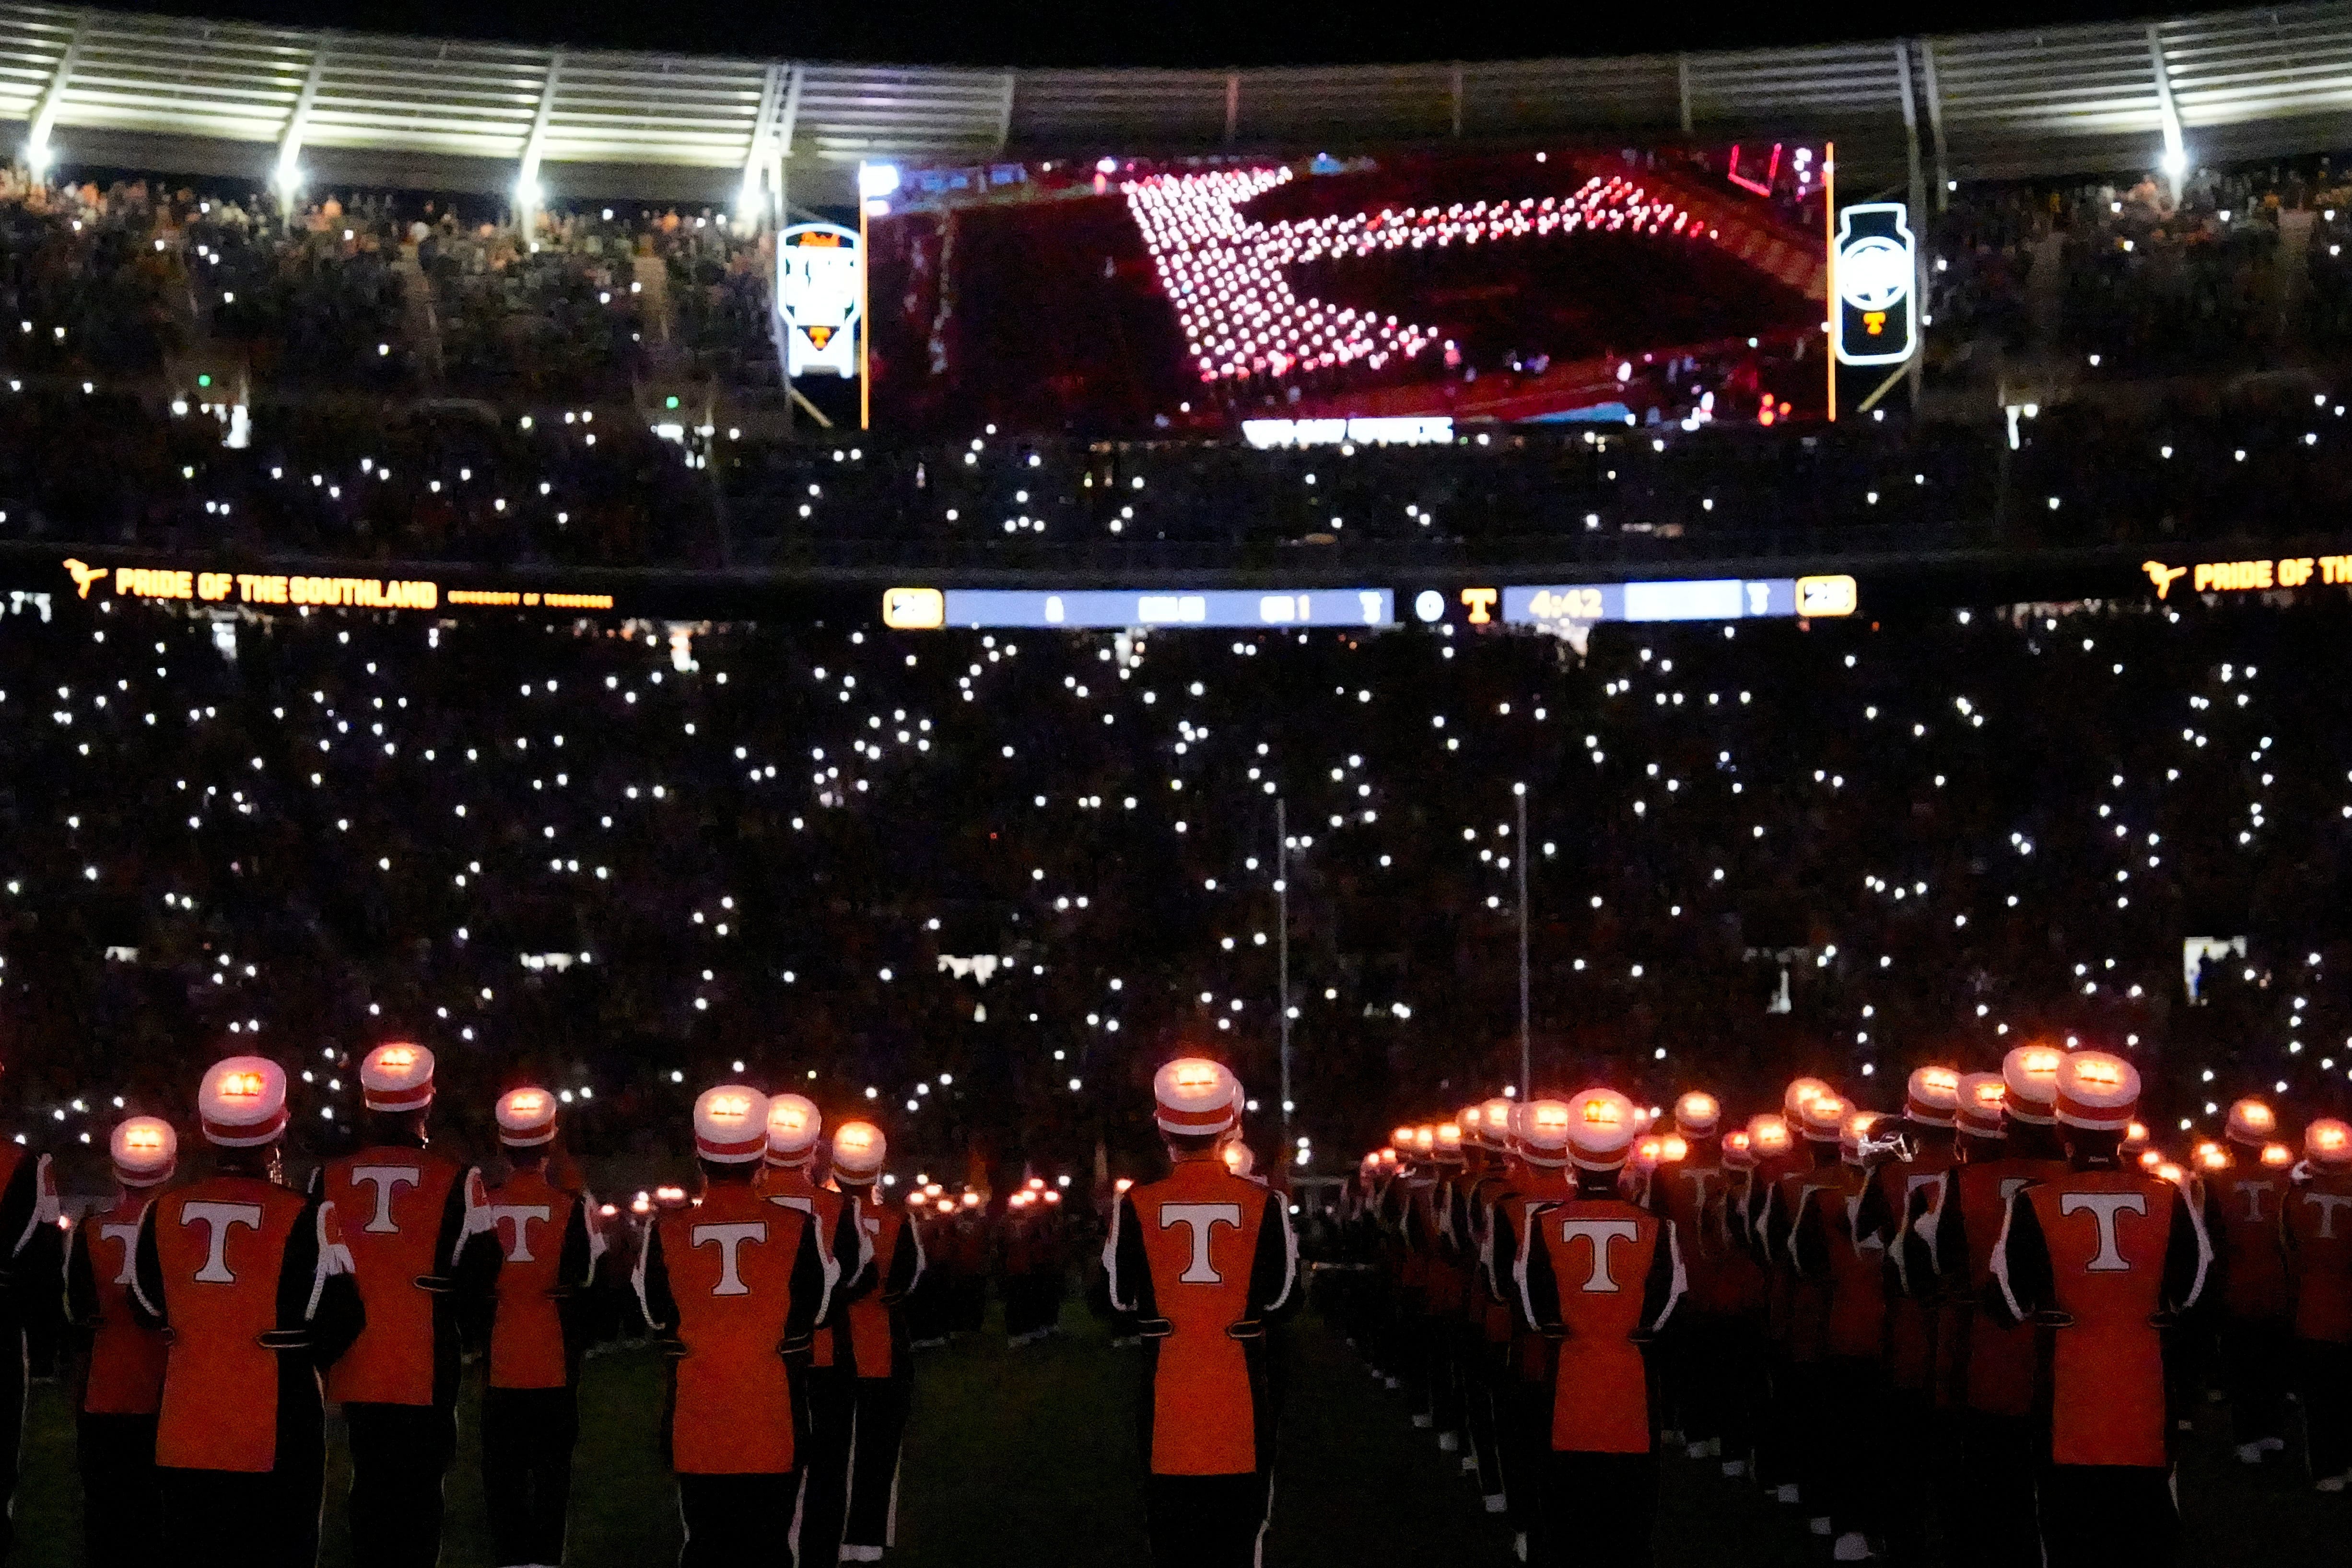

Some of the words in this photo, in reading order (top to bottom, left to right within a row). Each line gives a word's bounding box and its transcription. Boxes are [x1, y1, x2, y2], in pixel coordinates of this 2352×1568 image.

[116, 567, 193, 599] PRIDE
[197, 572, 233, 601] OF
[236, 574, 289, 604] THE
[289, 576, 438, 609] SOUTHLAND
[1529, 588, 1604, 618] 4:42
[2194, 559, 2274, 592] PRIDE
[2278, 557, 2315, 587] OF
[1461, 588, 1497, 624] T
[351, 1166, 420, 1233] T
[2235, 1180, 2275, 1222] T
[2303, 1193, 2352, 1239] T
[180, 1201, 262, 1283] T
[491, 1205, 550, 1262] T
[693, 1222, 767, 1296] T
[1160, 1203, 1241, 1283] T
[1563, 1220, 1638, 1292] T
[2060, 1193, 2147, 1270] T
